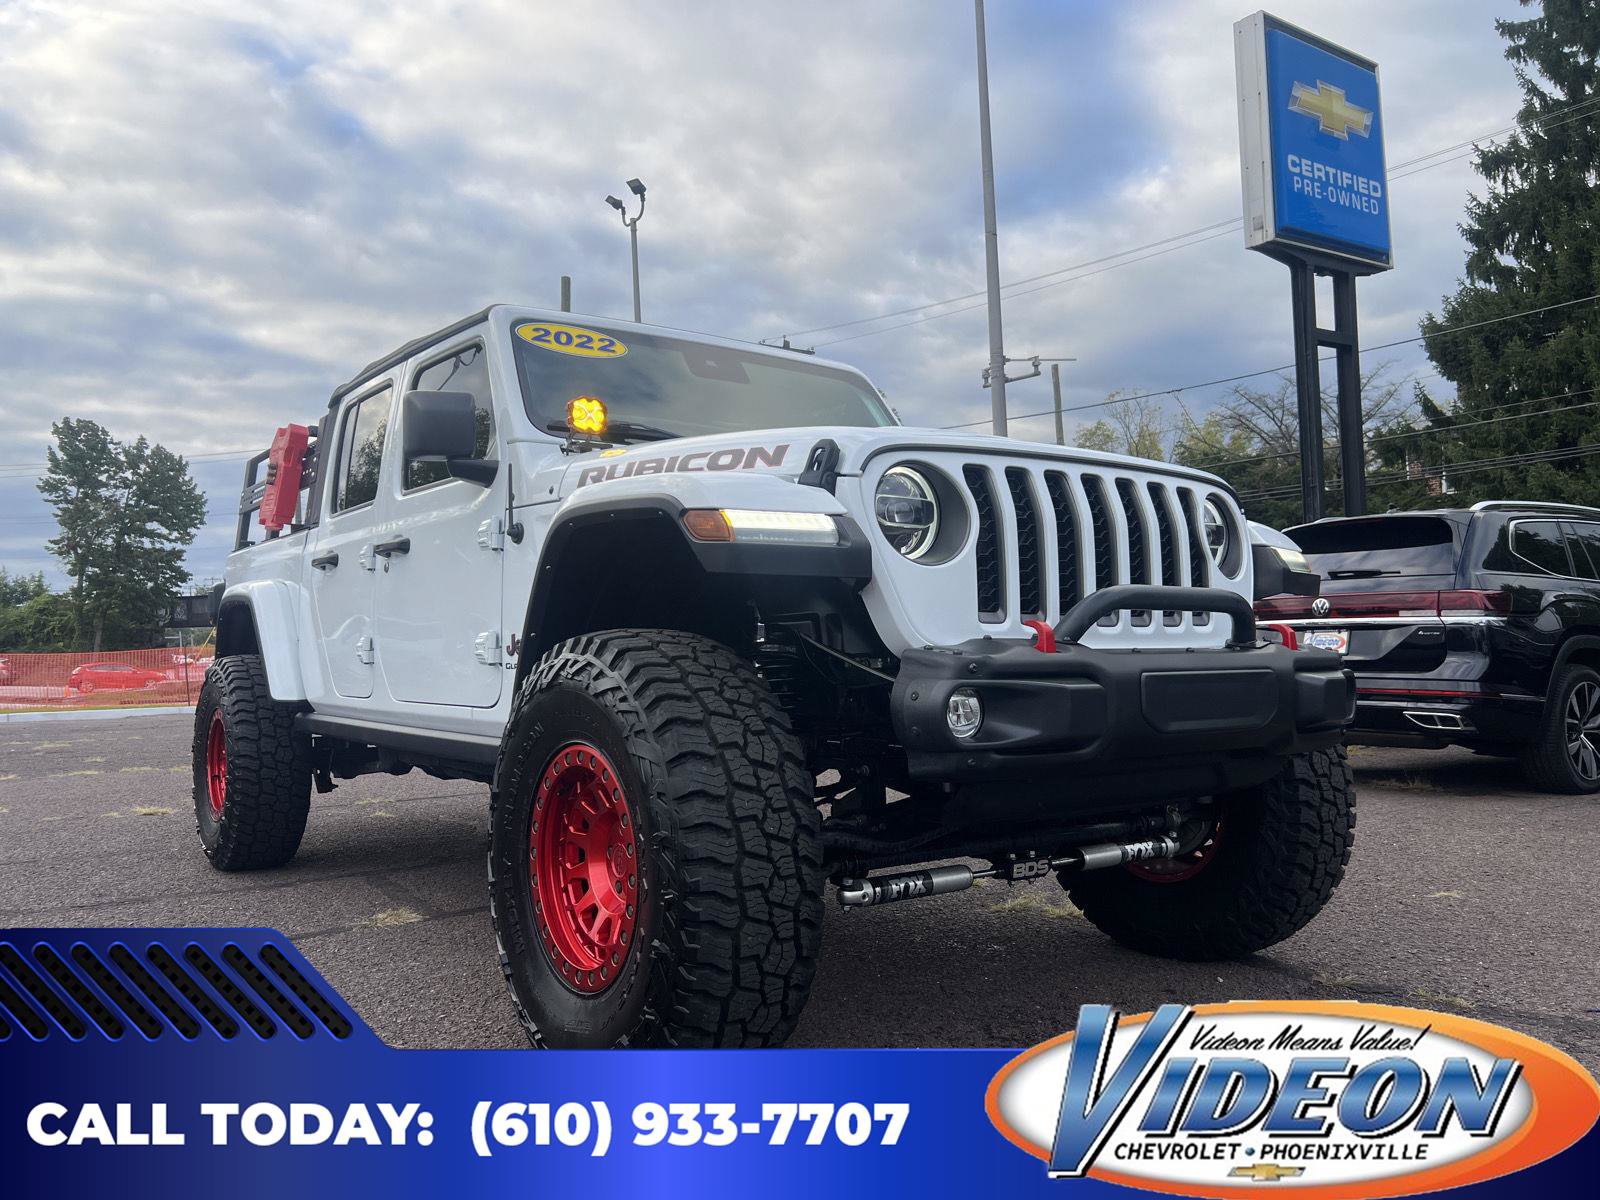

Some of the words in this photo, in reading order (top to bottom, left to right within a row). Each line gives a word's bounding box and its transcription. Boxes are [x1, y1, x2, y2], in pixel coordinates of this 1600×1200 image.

[1287, 154, 1382, 198] CERTIFIED
[1293, 176, 1379, 215] PRE-OWNED
[530, 327, 616, 353] 2022
[577, 444, 790, 488] RUBICON
[1013, 859, 1049, 879] BDS
[888, 875, 928, 899] FOX
